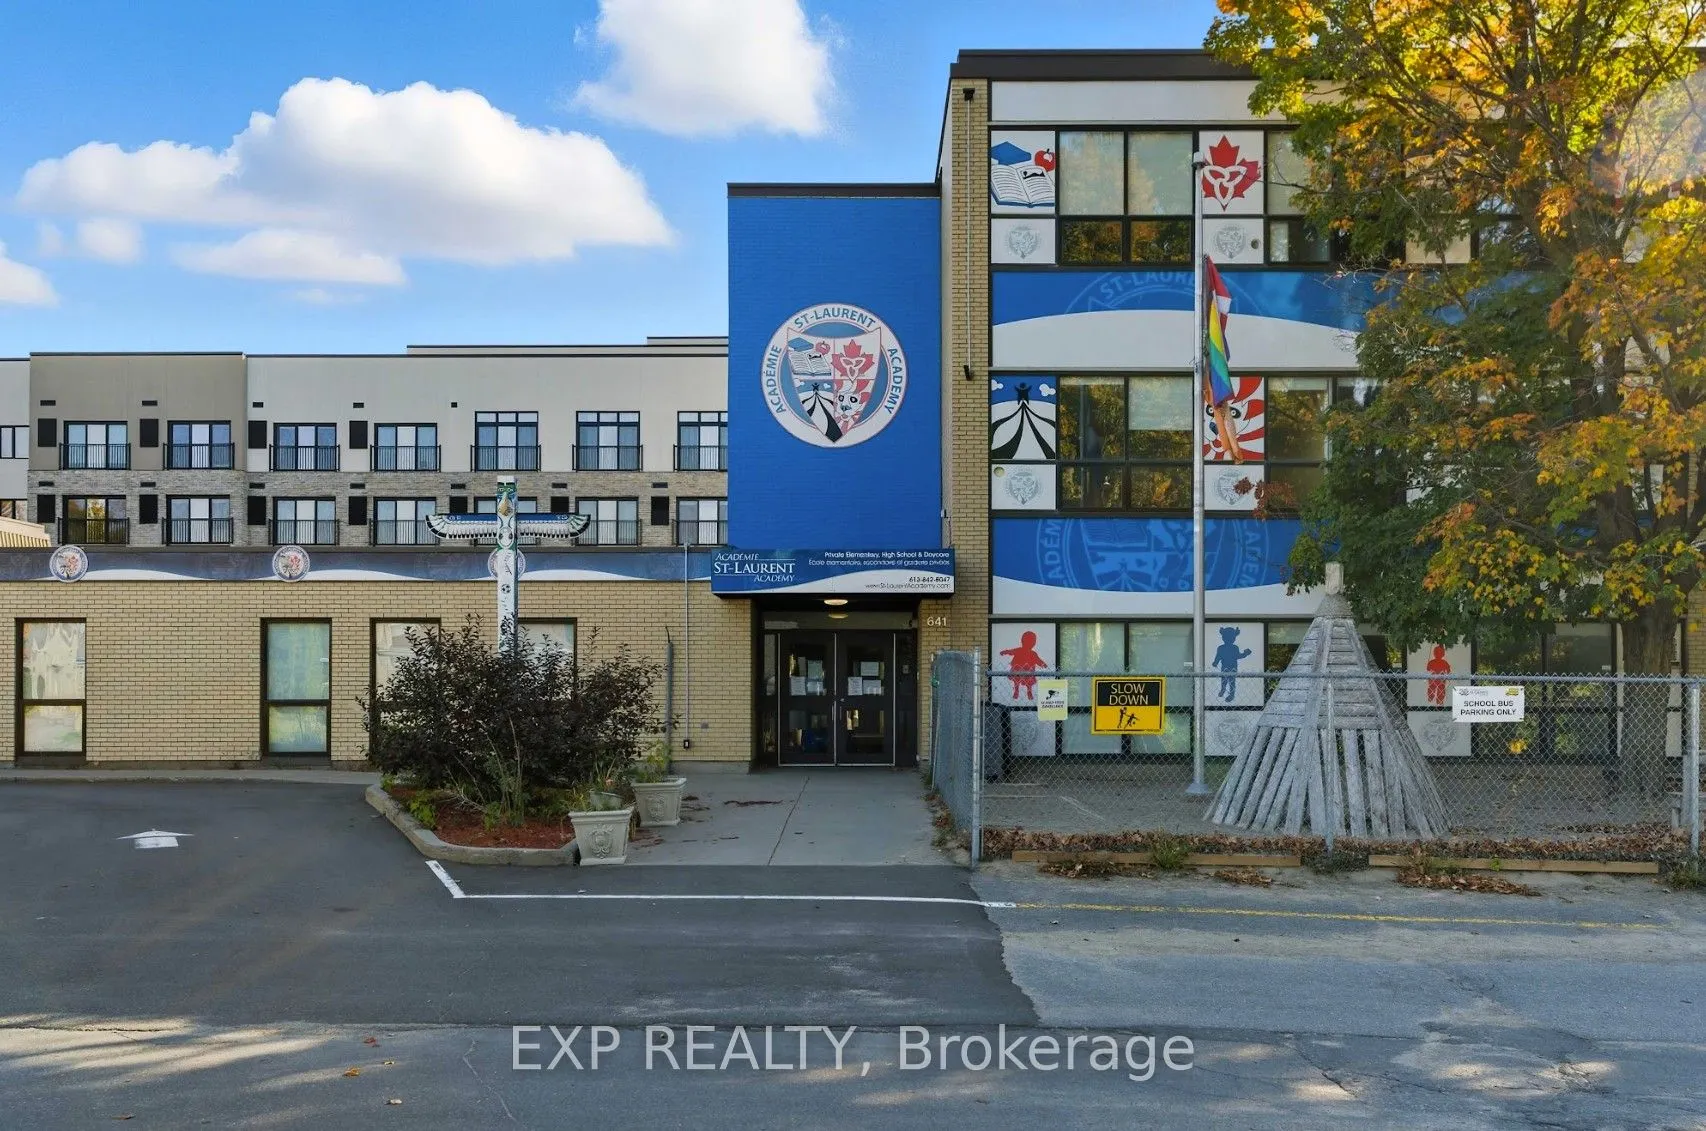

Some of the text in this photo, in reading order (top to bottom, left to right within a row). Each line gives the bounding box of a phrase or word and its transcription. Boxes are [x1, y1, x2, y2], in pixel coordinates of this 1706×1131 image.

[794, 308, 876, 329] ST-LAURENT
[764, 345, 787, 414] ACADÉMIE
[888, 348, 903, 414] ACADEMY
[881, 551, 895, 559] High
[923, 551, 950, 560] Daycare
[714, 561, 796, 574] ST-LAURENT
[754, 574, 795, 582] ACADEMY
[926, 616, 947, 627] 641
[1110, 683, 1146, 694] SLOW
[1109, 695, 1149, 705] DOWN
